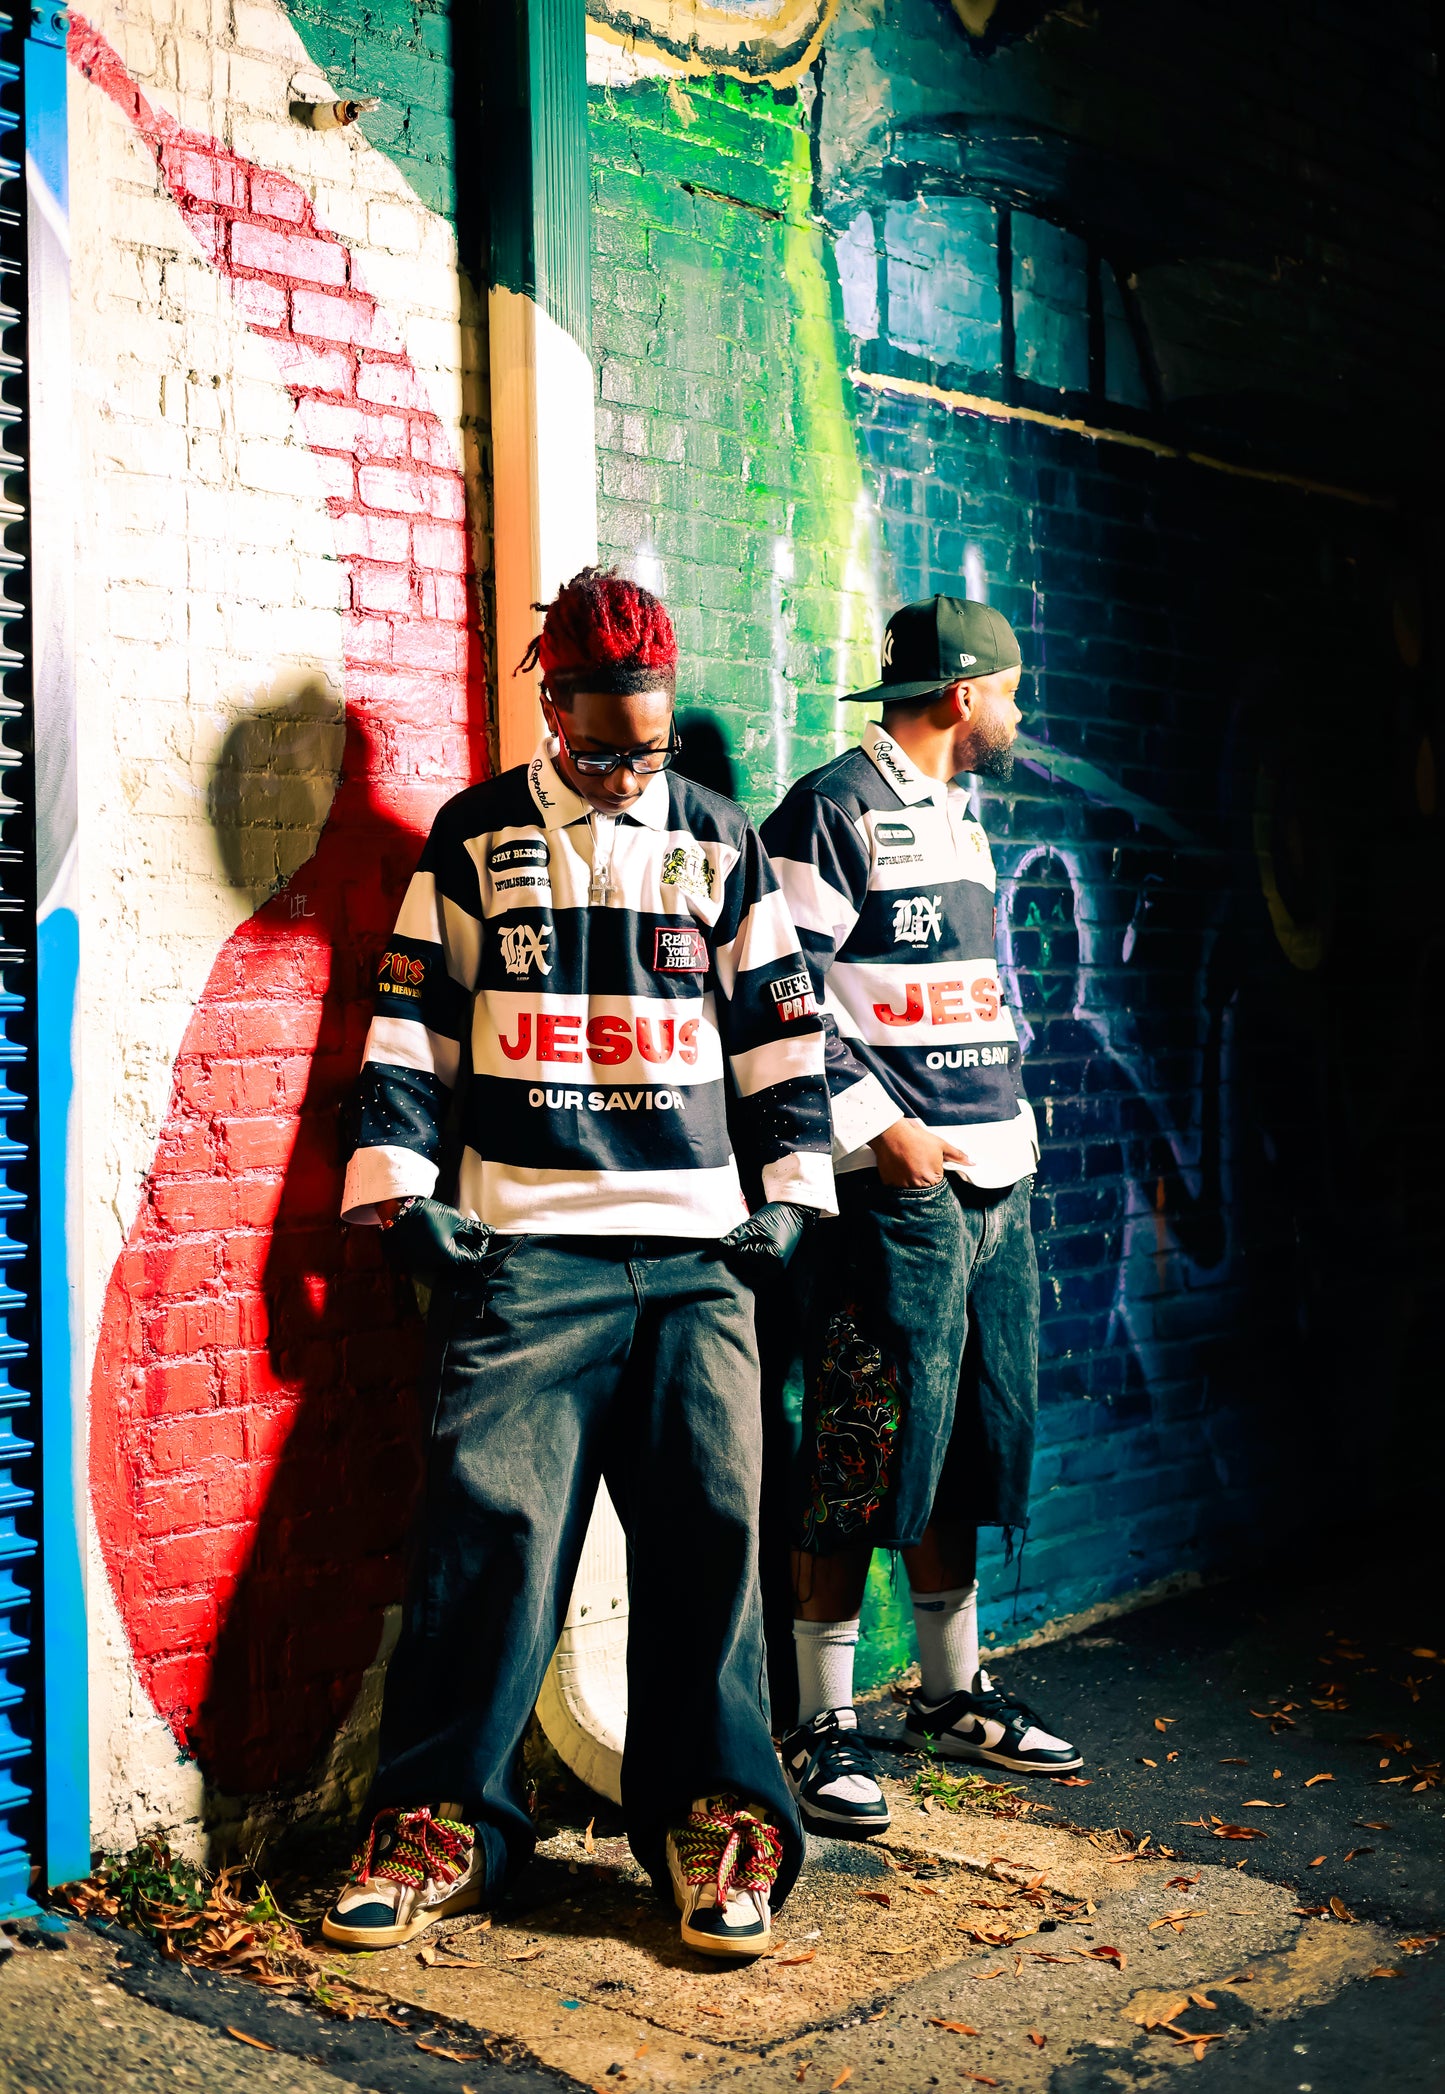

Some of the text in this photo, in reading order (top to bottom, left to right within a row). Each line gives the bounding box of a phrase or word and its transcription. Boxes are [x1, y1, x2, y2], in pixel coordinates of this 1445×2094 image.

[530, 759, 556, 808] Repented
[492, 850, 511, 863] STAY
[660, 933, 692, 946] READ
[664, 956, 697, 968] BIBLE
[666, 946, 691, 957] YOUR
[378, 982, 391, 992] TO
[773, 975, 809, 1000] LIFE'S
[872, 977, 1001, 1027] JES
[498, 1012, 700, 1066] JESUS
[926, 1049, 979, 1070] OUR
[528, 1087, 686, 1112] OUR SAVIOR
